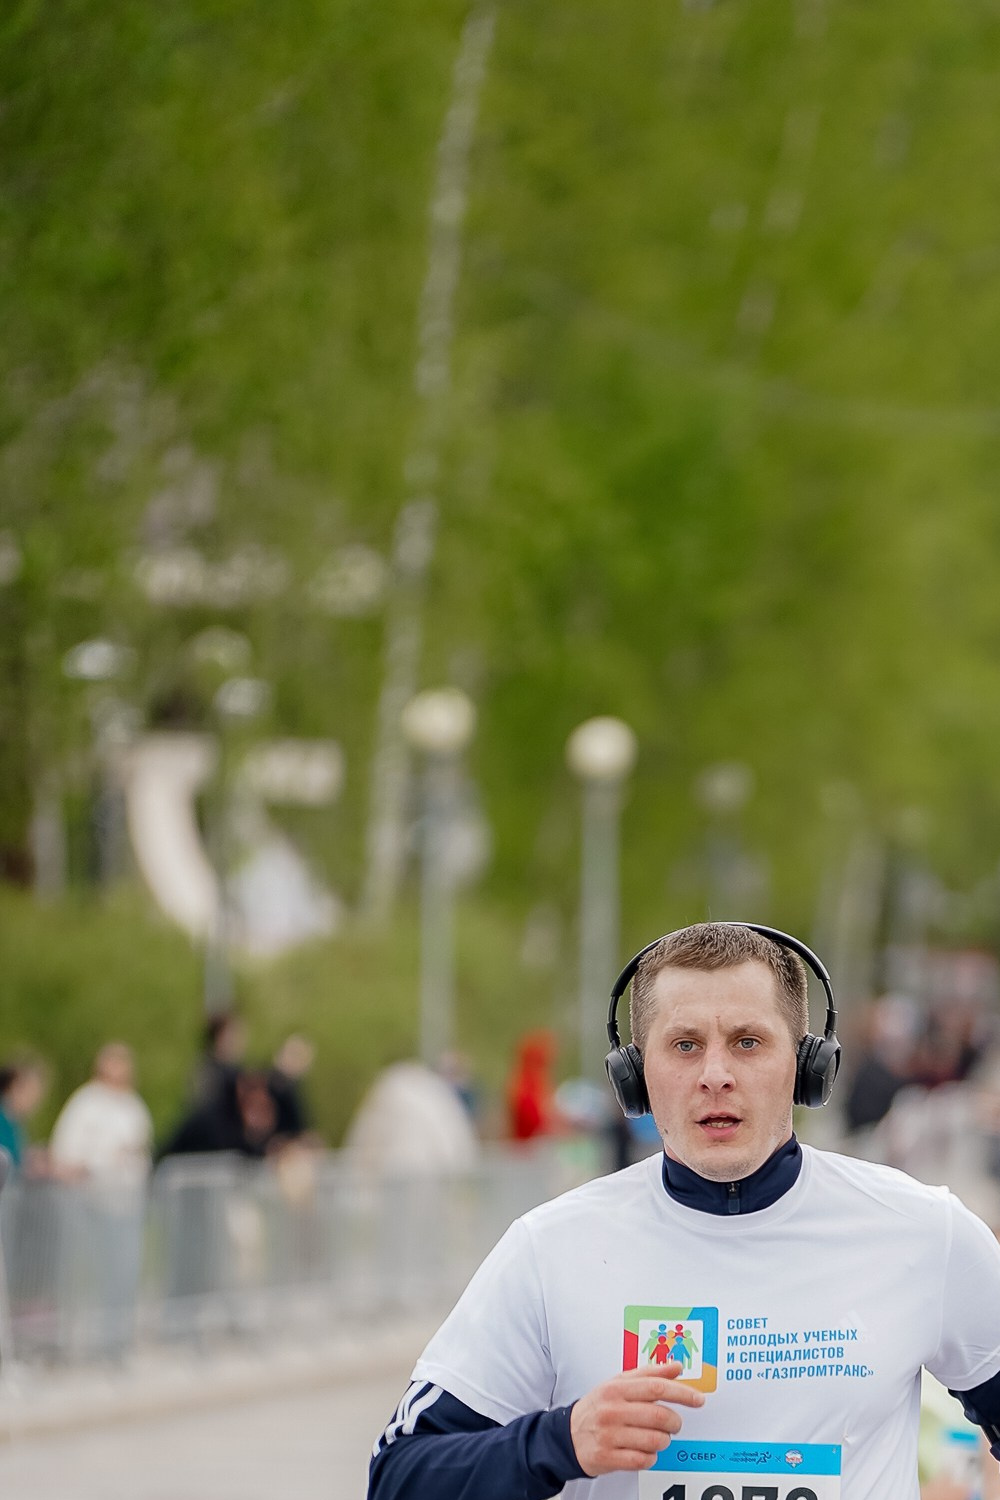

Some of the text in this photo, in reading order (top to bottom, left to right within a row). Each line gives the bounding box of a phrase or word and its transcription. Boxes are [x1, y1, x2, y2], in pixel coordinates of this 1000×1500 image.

[726, 1317, 769, 1330] СОВЕТ
[726, 1329, 858, 1347] МОЛОДЫХ УЧЕНЫХ
[726, 1347, 845, 1364] И СПЕЦИАЛИСТОВ
[725, 1364, 875, 1382] ООО «ГАЗПРОМТРАНС»
[690, 1452, 717, 1461] СБЕР
